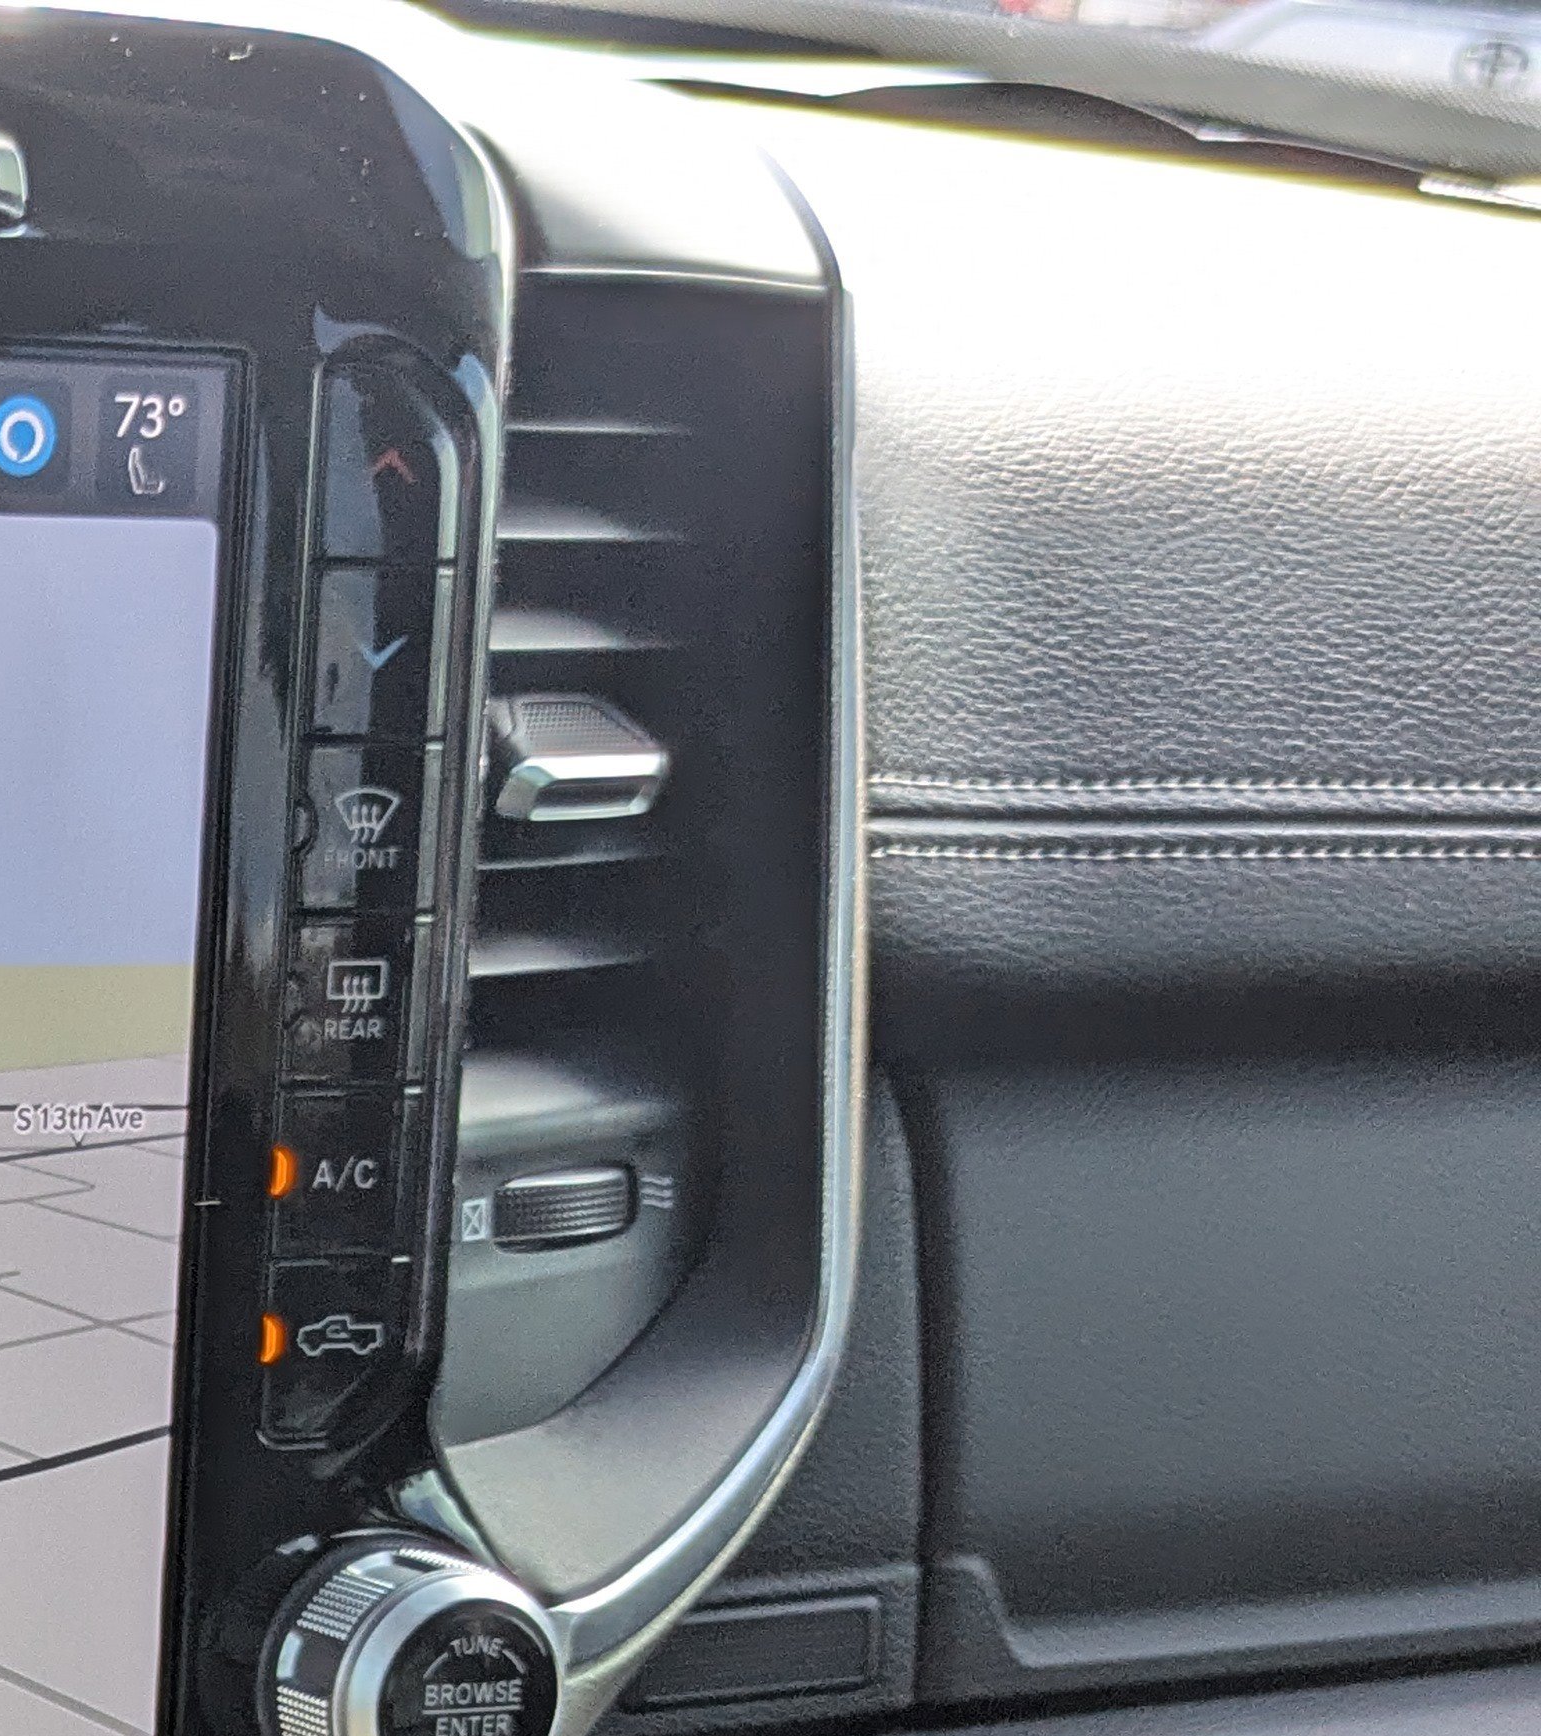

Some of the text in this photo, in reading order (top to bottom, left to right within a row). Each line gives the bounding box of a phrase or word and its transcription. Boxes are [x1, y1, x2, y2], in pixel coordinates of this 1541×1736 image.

[114, 392, 185, 439] 73°
[324, 1018, 382, 1039] REAR
[16, 1107, 142, 1130] S 13th Ave
[313, 1156, 376, 1192] A/C
[450, 1634, 504, 1659] TUNE
[424, 1678, 523, 1707] BROWSE
